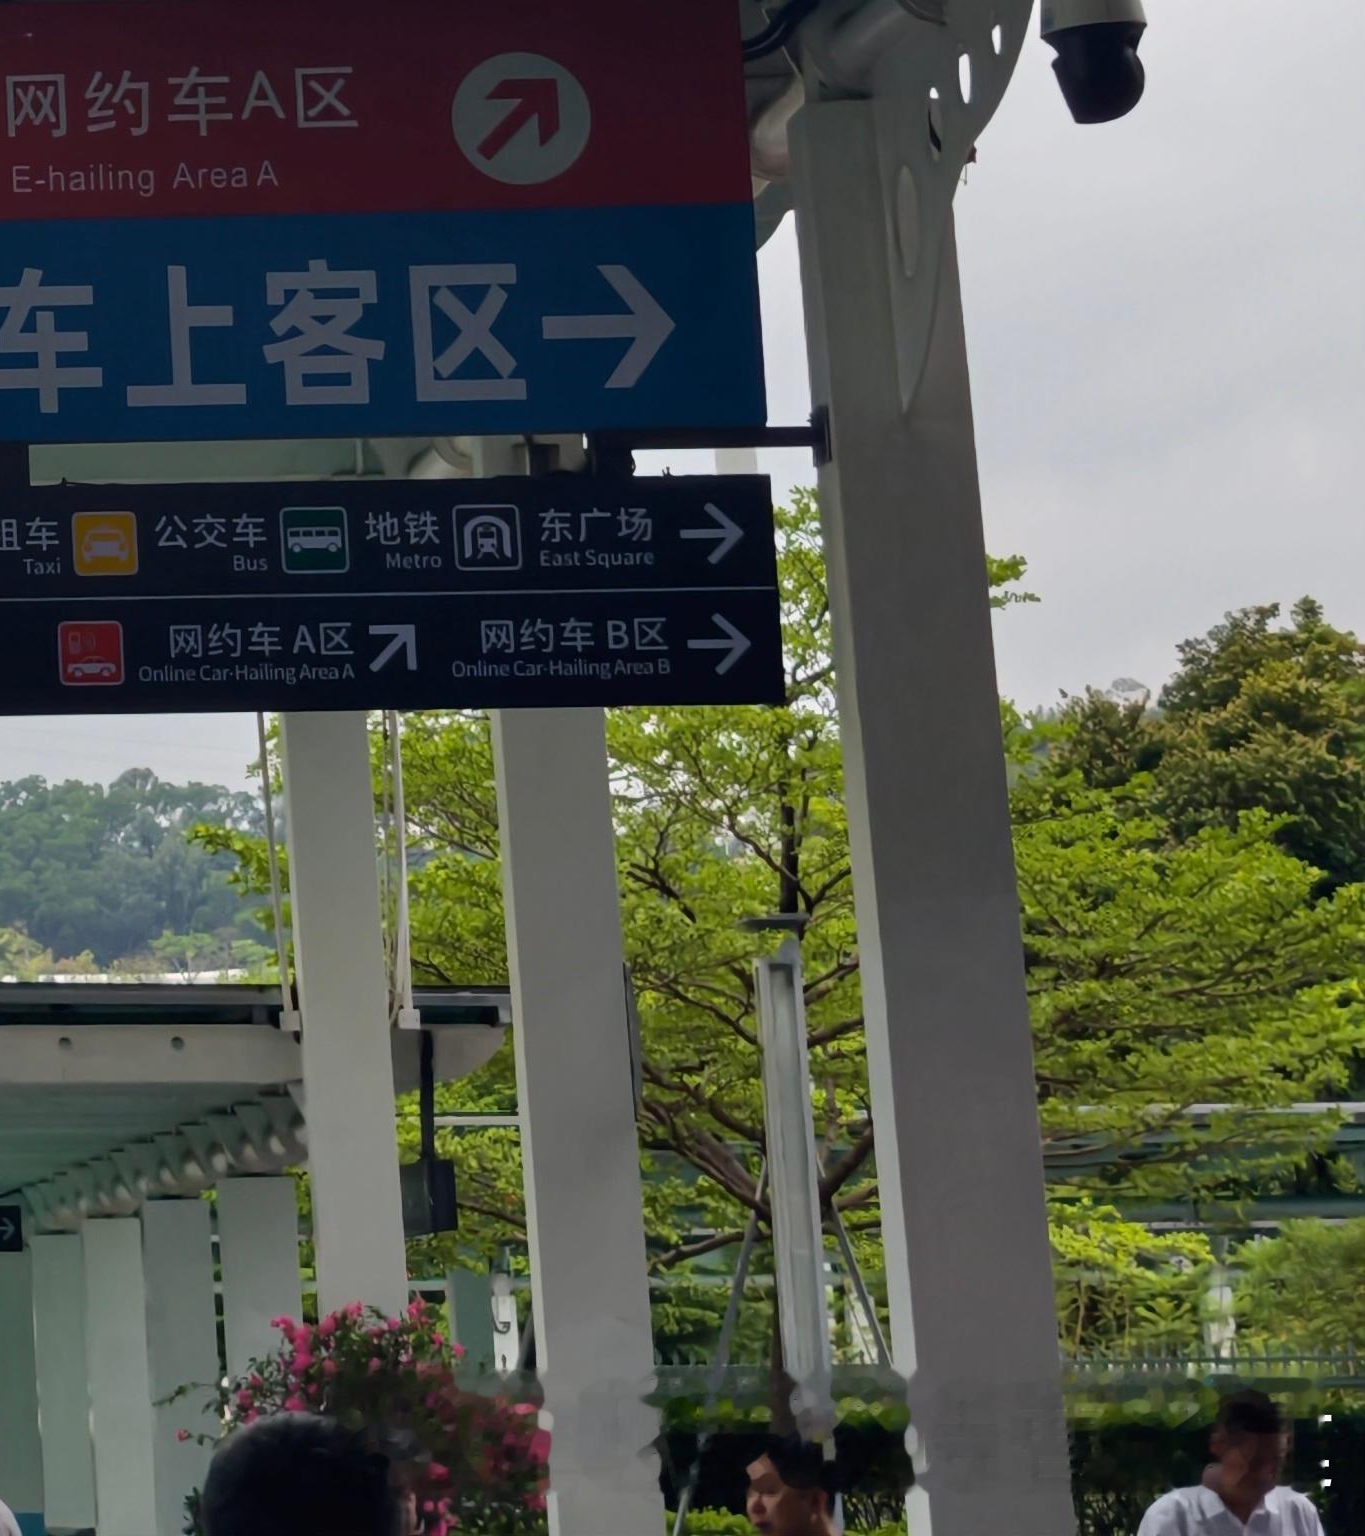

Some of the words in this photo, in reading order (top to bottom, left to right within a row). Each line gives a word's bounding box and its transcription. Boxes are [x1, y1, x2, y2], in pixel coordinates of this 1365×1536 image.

[5, 66, 359, 138] 网约车A区
[12, 164, 155, 197] E-hailing
[173, 162, 248, 189] Area
[257, 160, 279, 187] A
[154, 513, 267, 549] 公交车
[365, 511, 441, 545] 地铁
[539, 507, 653, 543] 东广场
[22, 557, 62, 575] Taxi
[232, 554, 269, 572] Bus
[385, 552, 443, 569] Metro
[539, 550, 581, 568] East
[585, 549, 656, 569] Square
[138, 664, 197, 682] Online
[299, 664, 340, 681] Area
[342, 664, 356, 679] A
[451, 660, 510, 678] Online
[614, 658, 655, 676] Area
[657, 658, 671, 674] B
